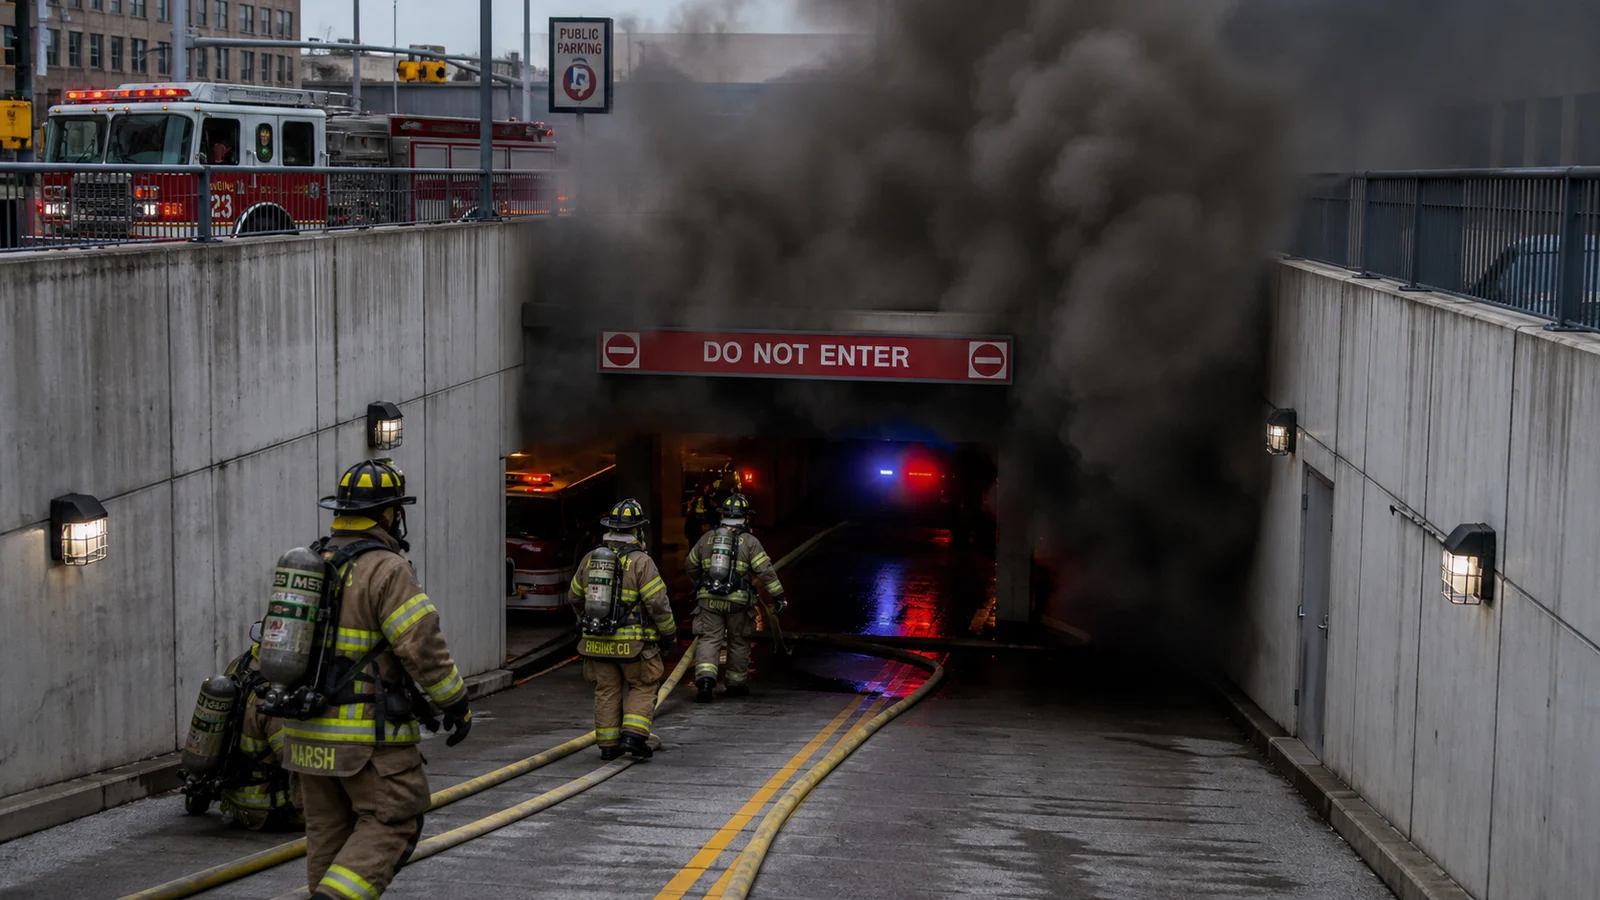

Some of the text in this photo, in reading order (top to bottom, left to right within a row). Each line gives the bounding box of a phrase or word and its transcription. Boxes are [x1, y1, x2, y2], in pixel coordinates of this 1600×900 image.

[560, 28, 598, 40] PUBLIC
[557, 42, 602, 55] PARKING
[210, 194, 232, 219] 23
[703, 341, 910, 368] DO NOT ENTER
[617, 643, 631, 655] CO
